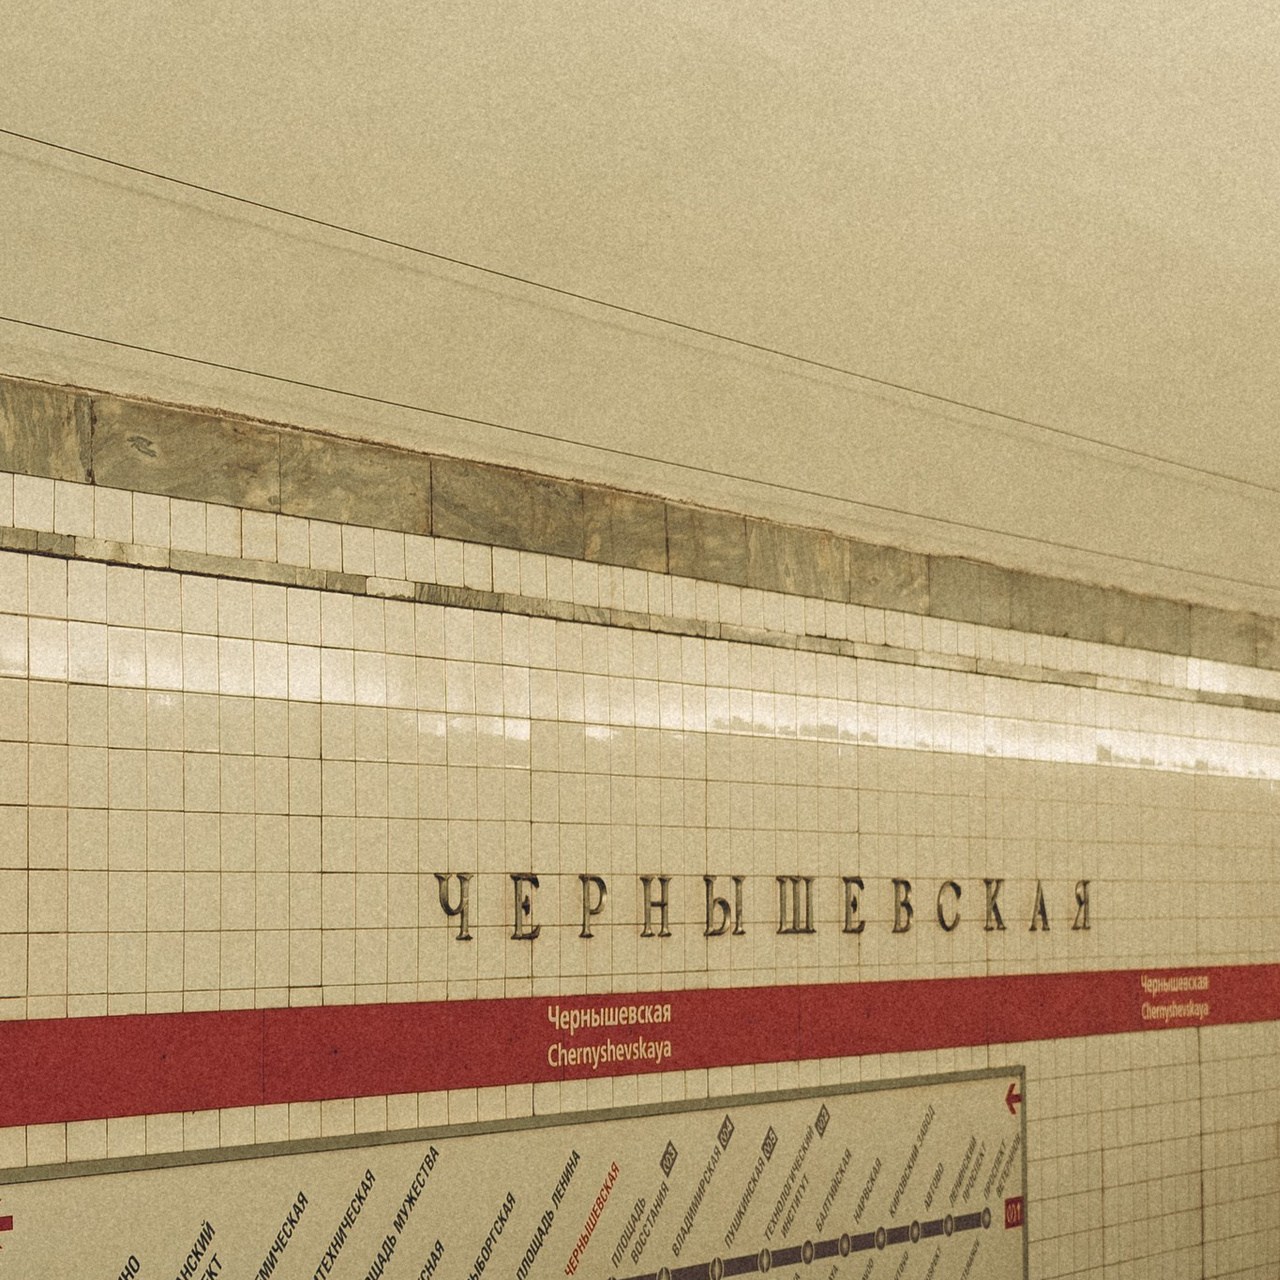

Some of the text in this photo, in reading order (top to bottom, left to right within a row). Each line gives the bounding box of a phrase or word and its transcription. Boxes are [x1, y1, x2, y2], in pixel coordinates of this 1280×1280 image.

[433, 872, 1091, 940] ЧЕРНЫШЕВСКАЯ
[547, 1004, 672, 1036] Чернышевская
[1140, 974, 1209, 998] Чернышевская
[1141, 999, 1209, 1023] Chernyshevskaya
[547, 1035, 672, 1070] Chernyshevskaya
[392, 1145, 440, 1234] МУЖЕСТВА
[550, 1149, 581, 1210] ЛЕНИНА
[671, 1145, 721, 1257] ВЛАДИМИРСКАЯ
[724, 1156, 765, 1249] ПУШКИНСКАЯ
[564, 1161, 620, 1276] ЧЕРНЫШЕВСКАЯ
[611, 1196, 646, 1269] ПЛОЩАДЬ
[630, 1180, 669, 1265] ВОССТАНИЯ
